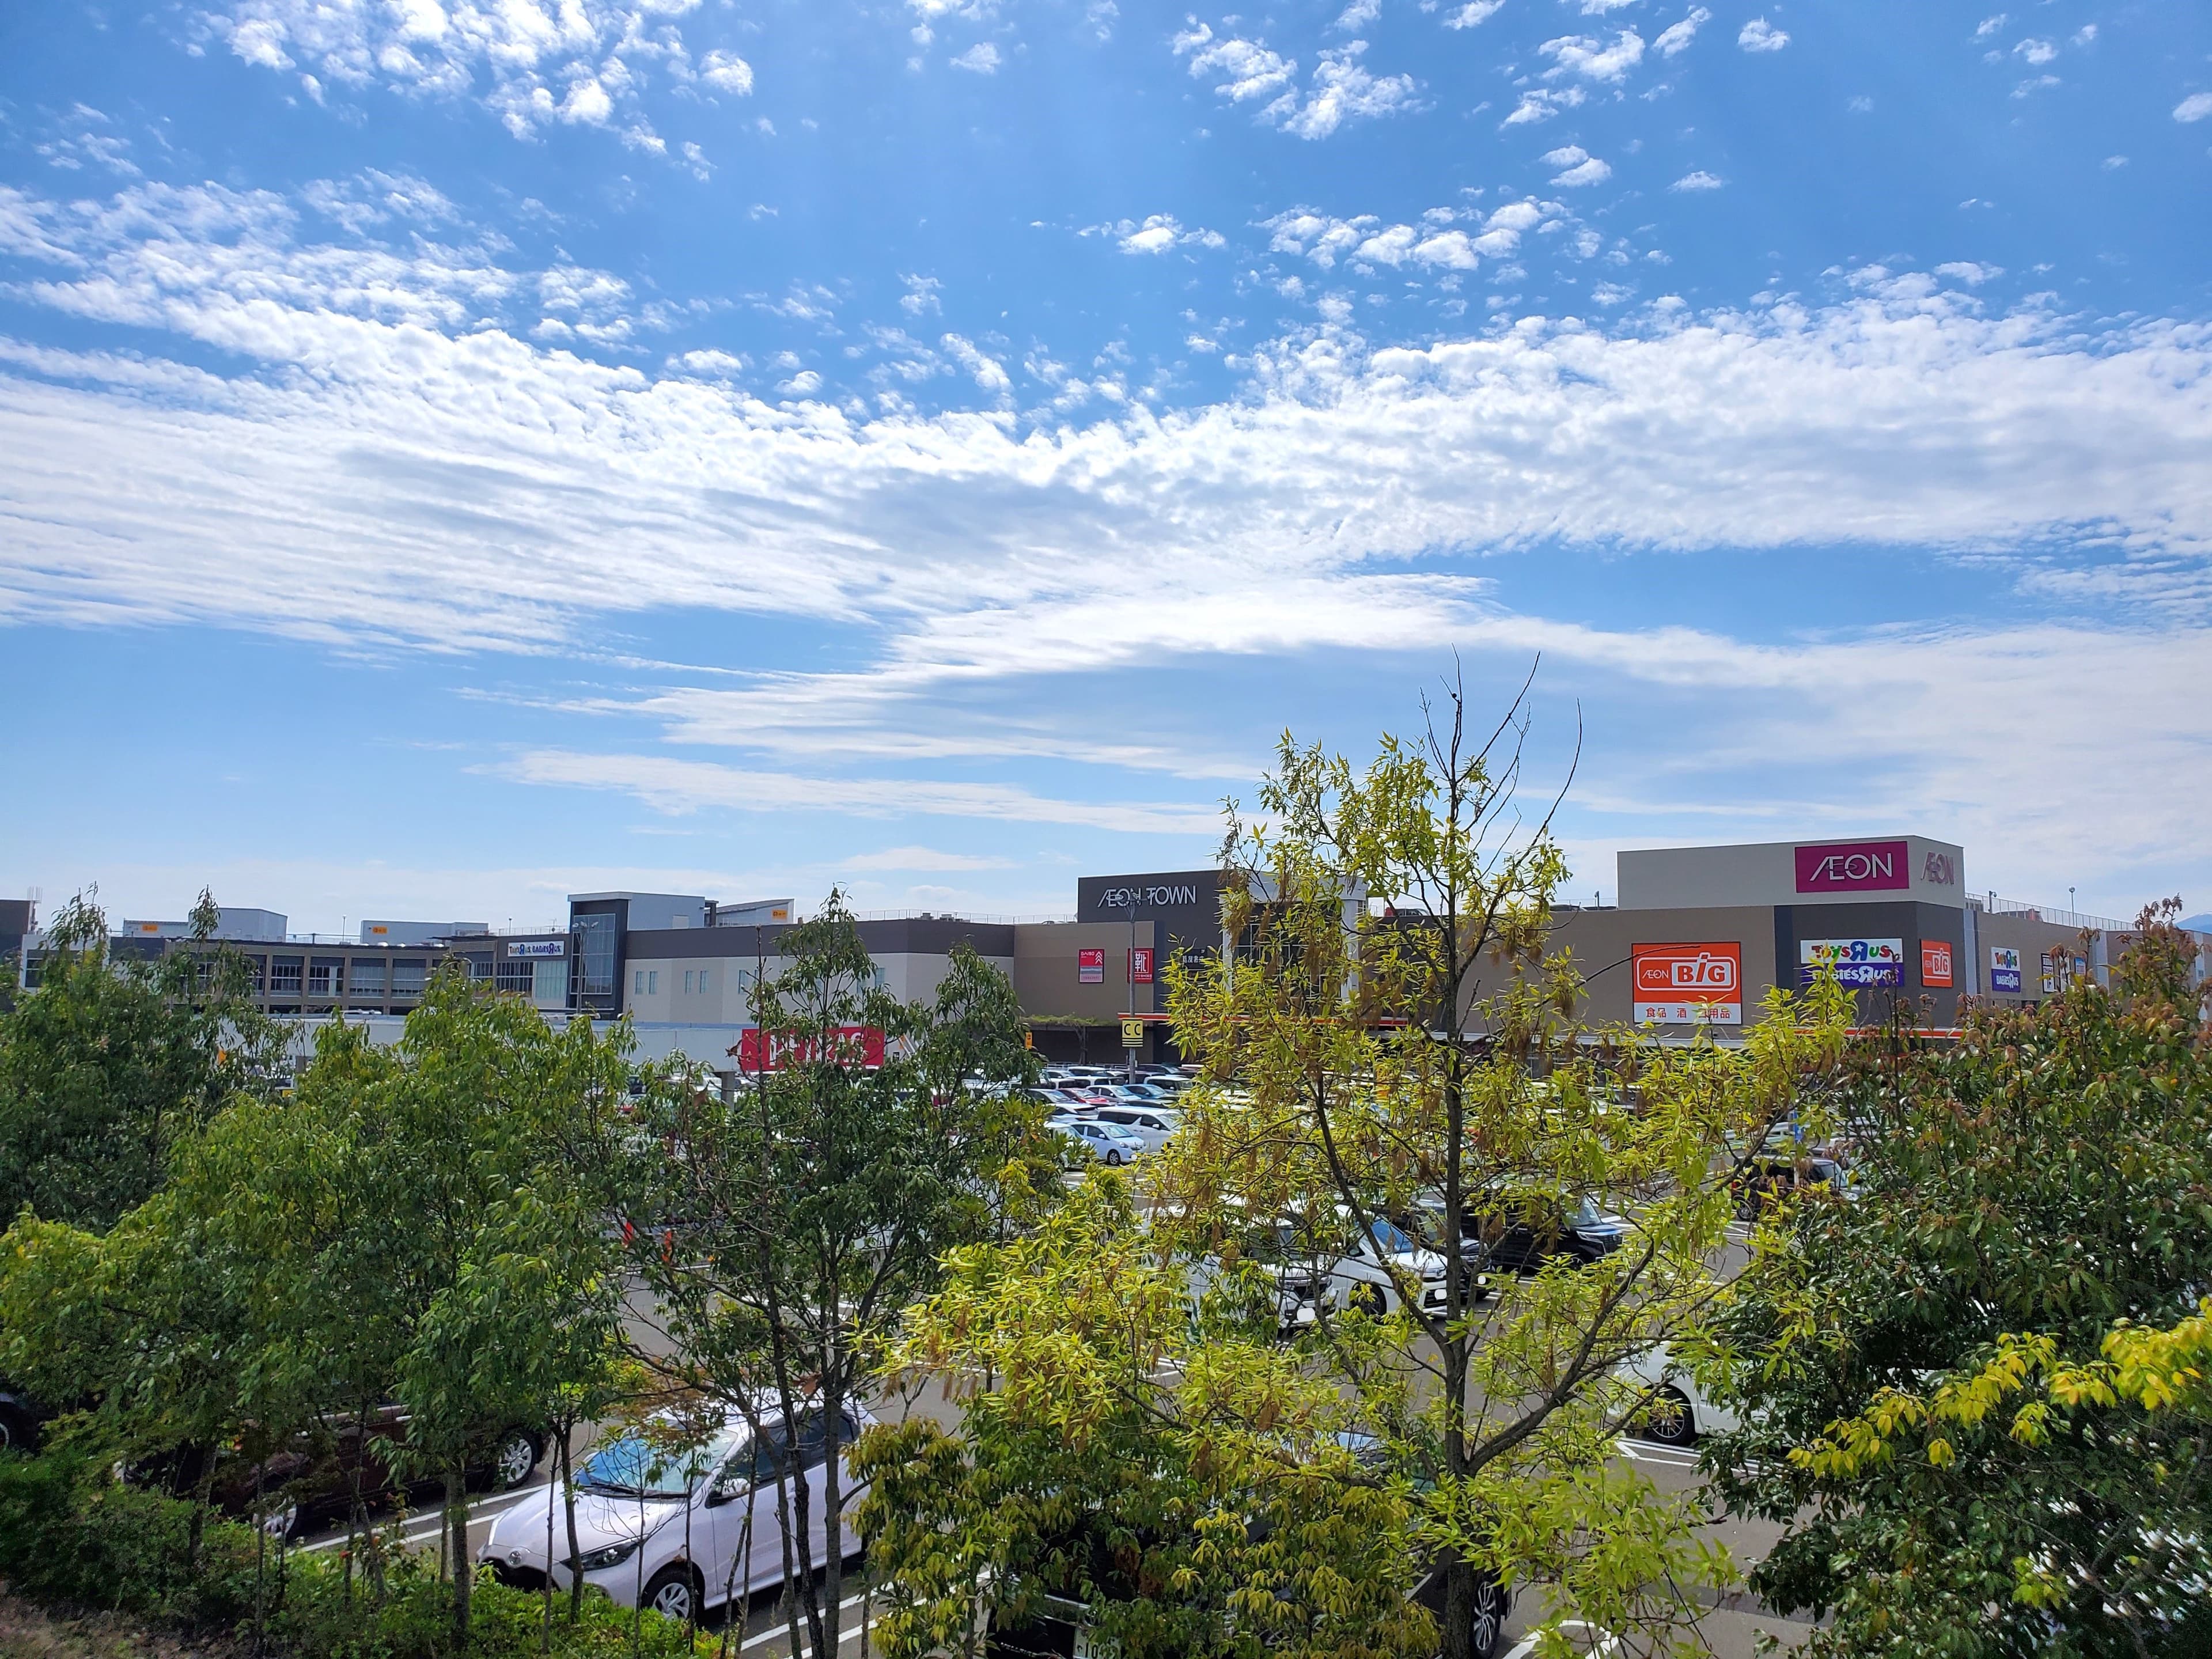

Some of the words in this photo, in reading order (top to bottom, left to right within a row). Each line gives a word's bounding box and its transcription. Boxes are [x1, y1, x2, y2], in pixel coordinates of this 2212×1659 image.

[1146, 885, 1196, 906] TOWN
[1677, 954, 1725, 982] BIG
[1646, 1007, 1666, 1018] 食品
[1677, 1008, 1687, 1018] 酒
